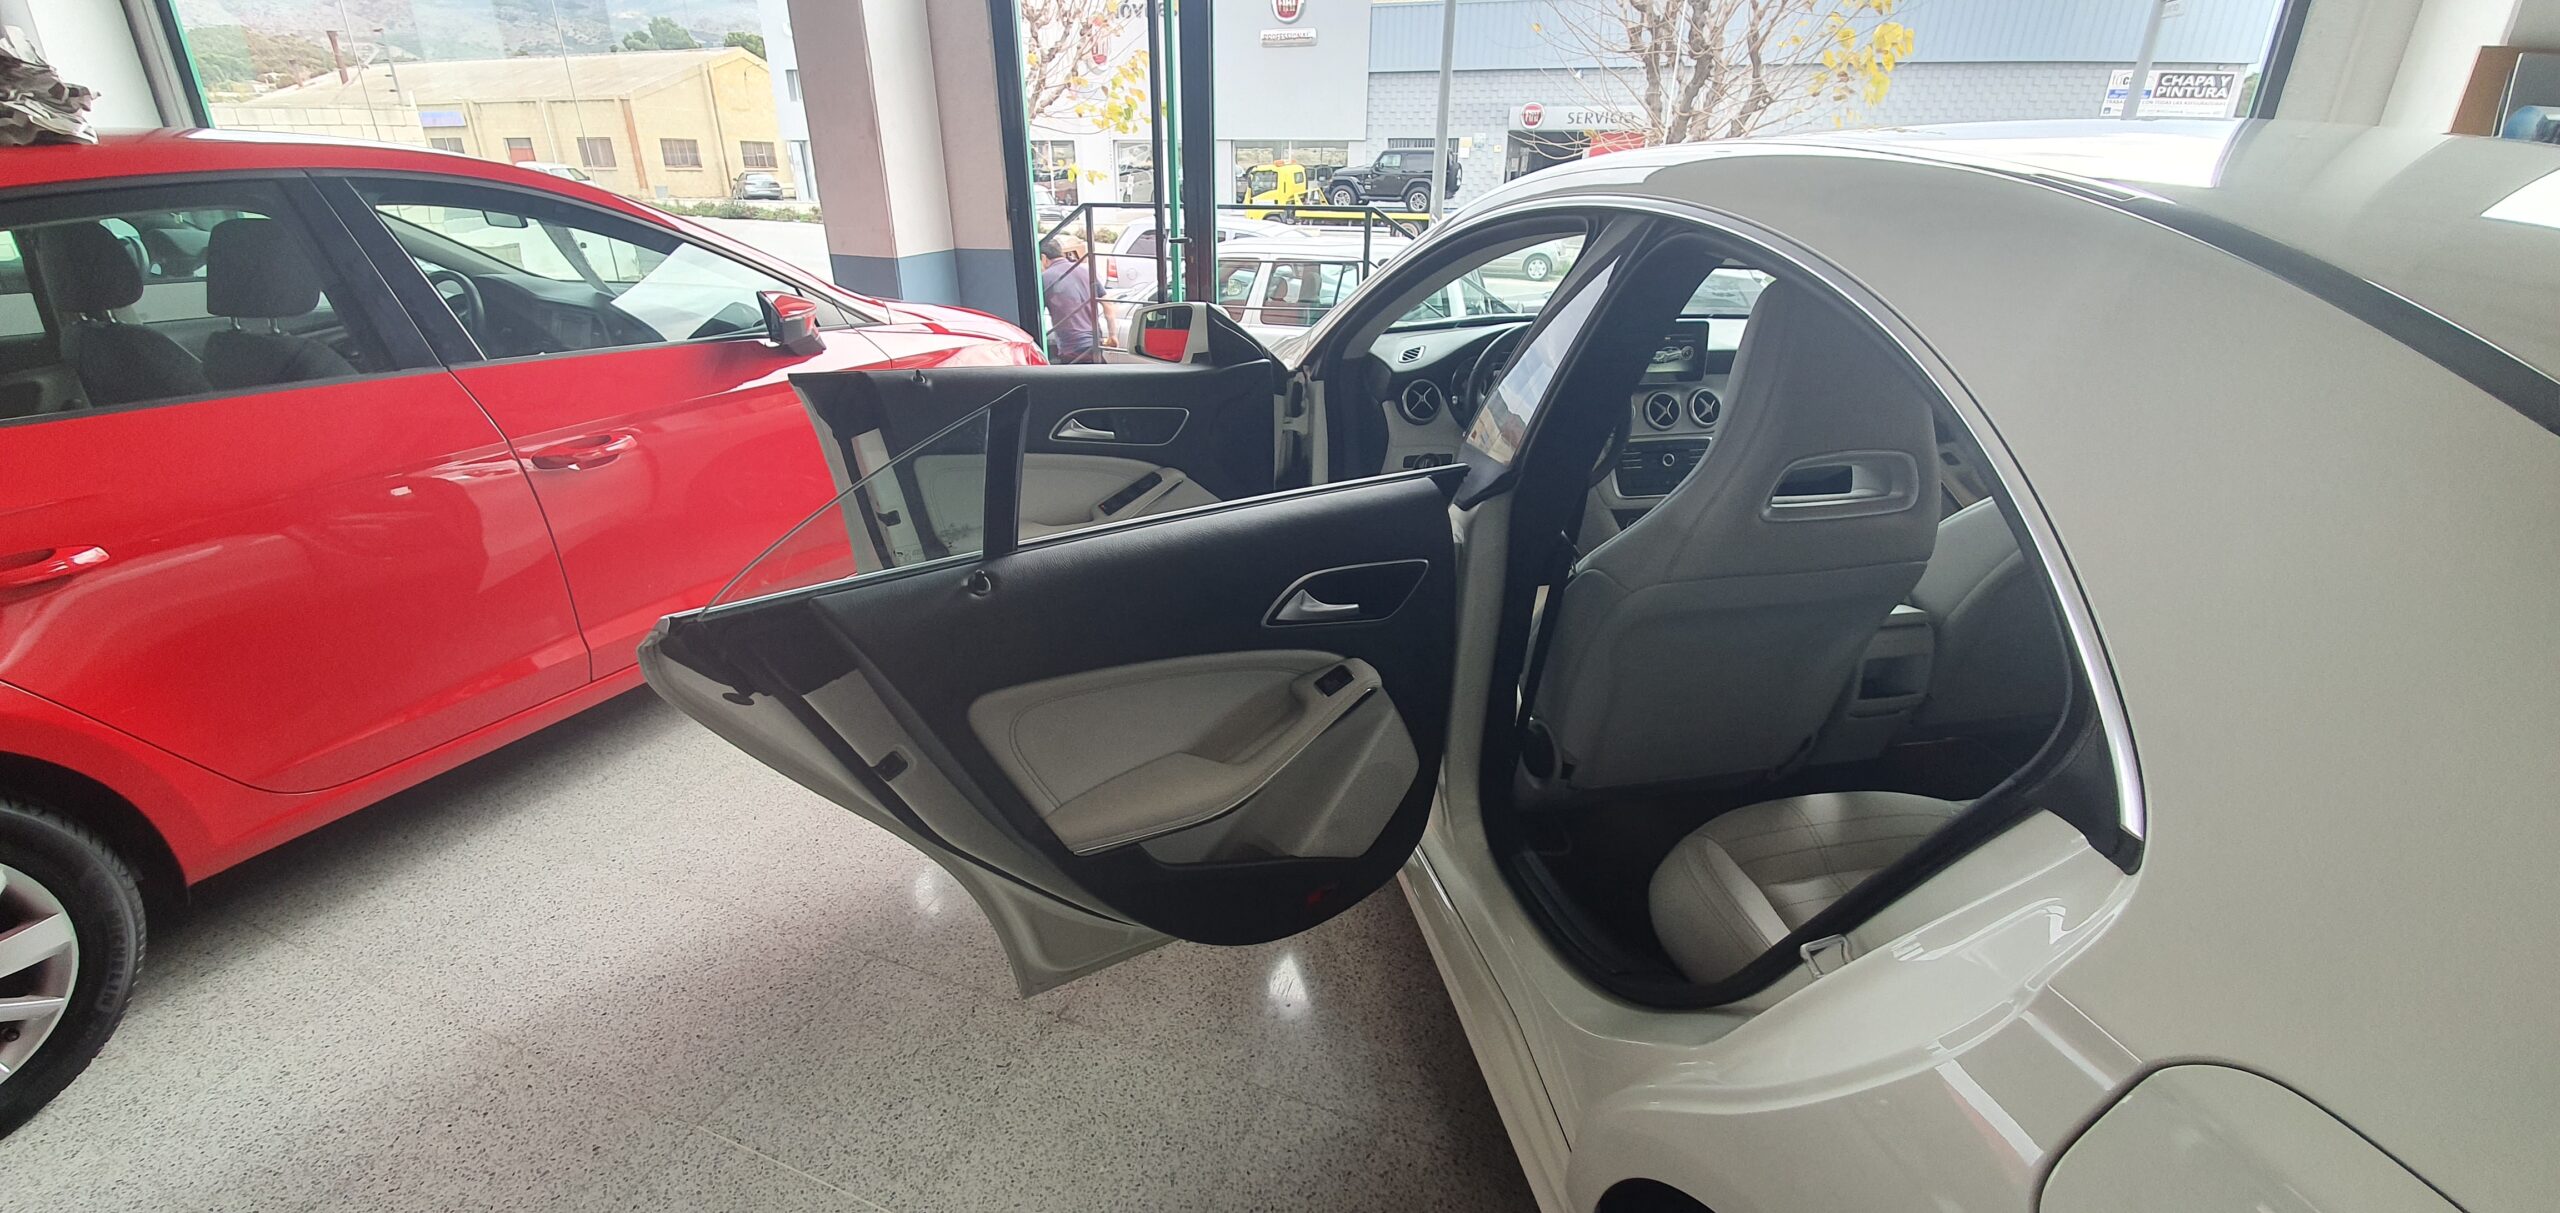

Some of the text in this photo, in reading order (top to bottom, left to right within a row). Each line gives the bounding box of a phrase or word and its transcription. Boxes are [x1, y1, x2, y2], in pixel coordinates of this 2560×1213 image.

[2162, 75, 2232, 87] CHAPA Y
[2156, 86, 2229, 98] PINTURA
